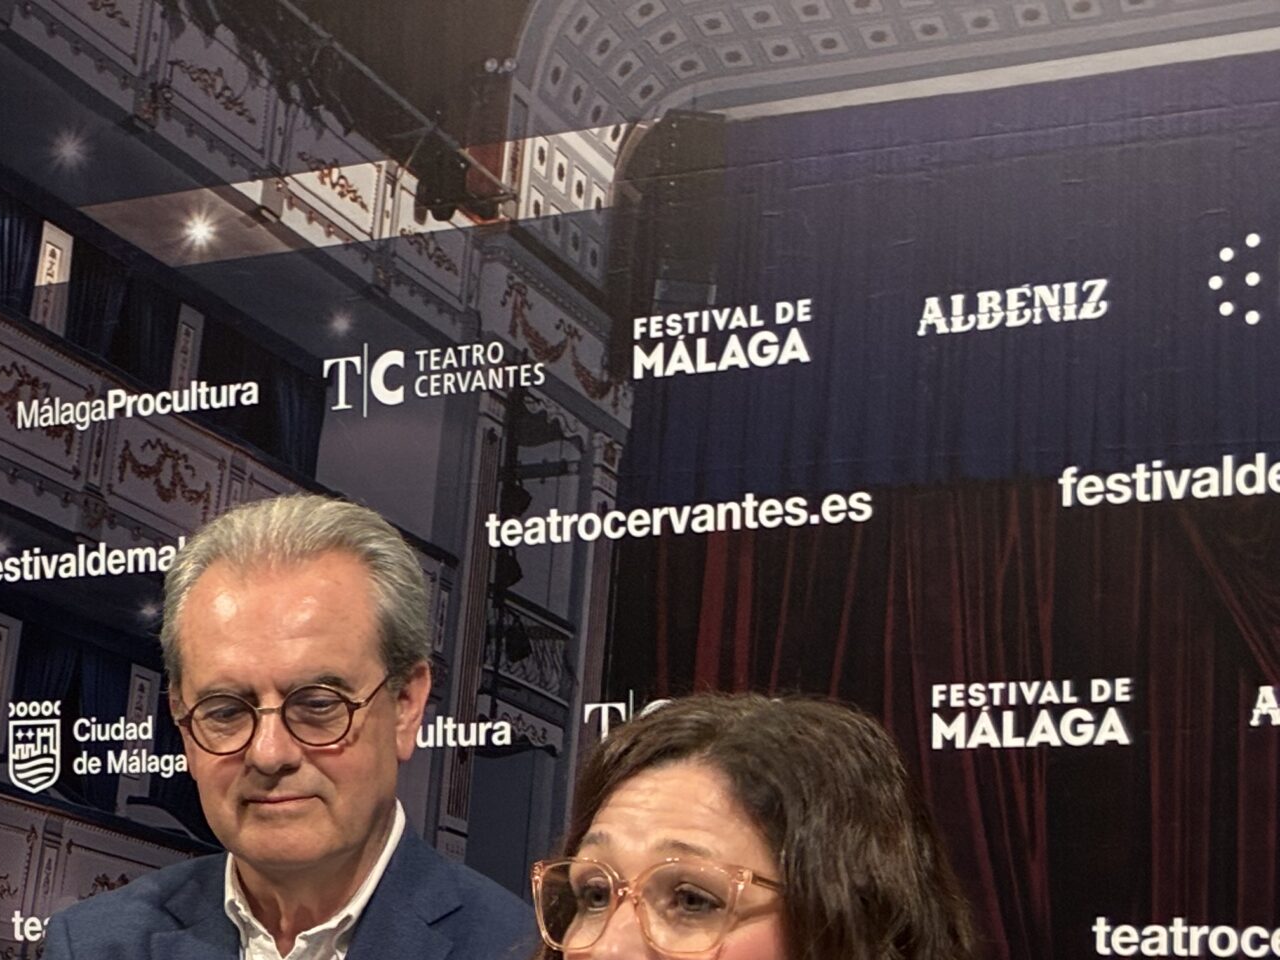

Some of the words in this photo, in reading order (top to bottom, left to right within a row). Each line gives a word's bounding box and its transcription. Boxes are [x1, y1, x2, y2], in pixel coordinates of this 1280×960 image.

[633, 304, 764, 341] FESTIVAL
[774, 298, 813, 325] DE
[917, 278, 1109, 336] ALBÉNIZ
[415, 340, 504, 373] TEATRO
[633, 327, 811, 380] MÁLAGA
[415, 363, 545, 398] CERVANTES
[16, 378, 259, 432] MálagaProcultura
[485, 489, 873, 548] teatrocervantes.es
[932, 681, 1080, 708] FESTIVAL
[1091, 678, 1132, 703] DE
[73, 715, 153, 741] Ciudad
[932, 705, 1131, 750] MÁLAGA
[73, 751, 101, 774] de
[107, 749, 187, 778] Málaga
